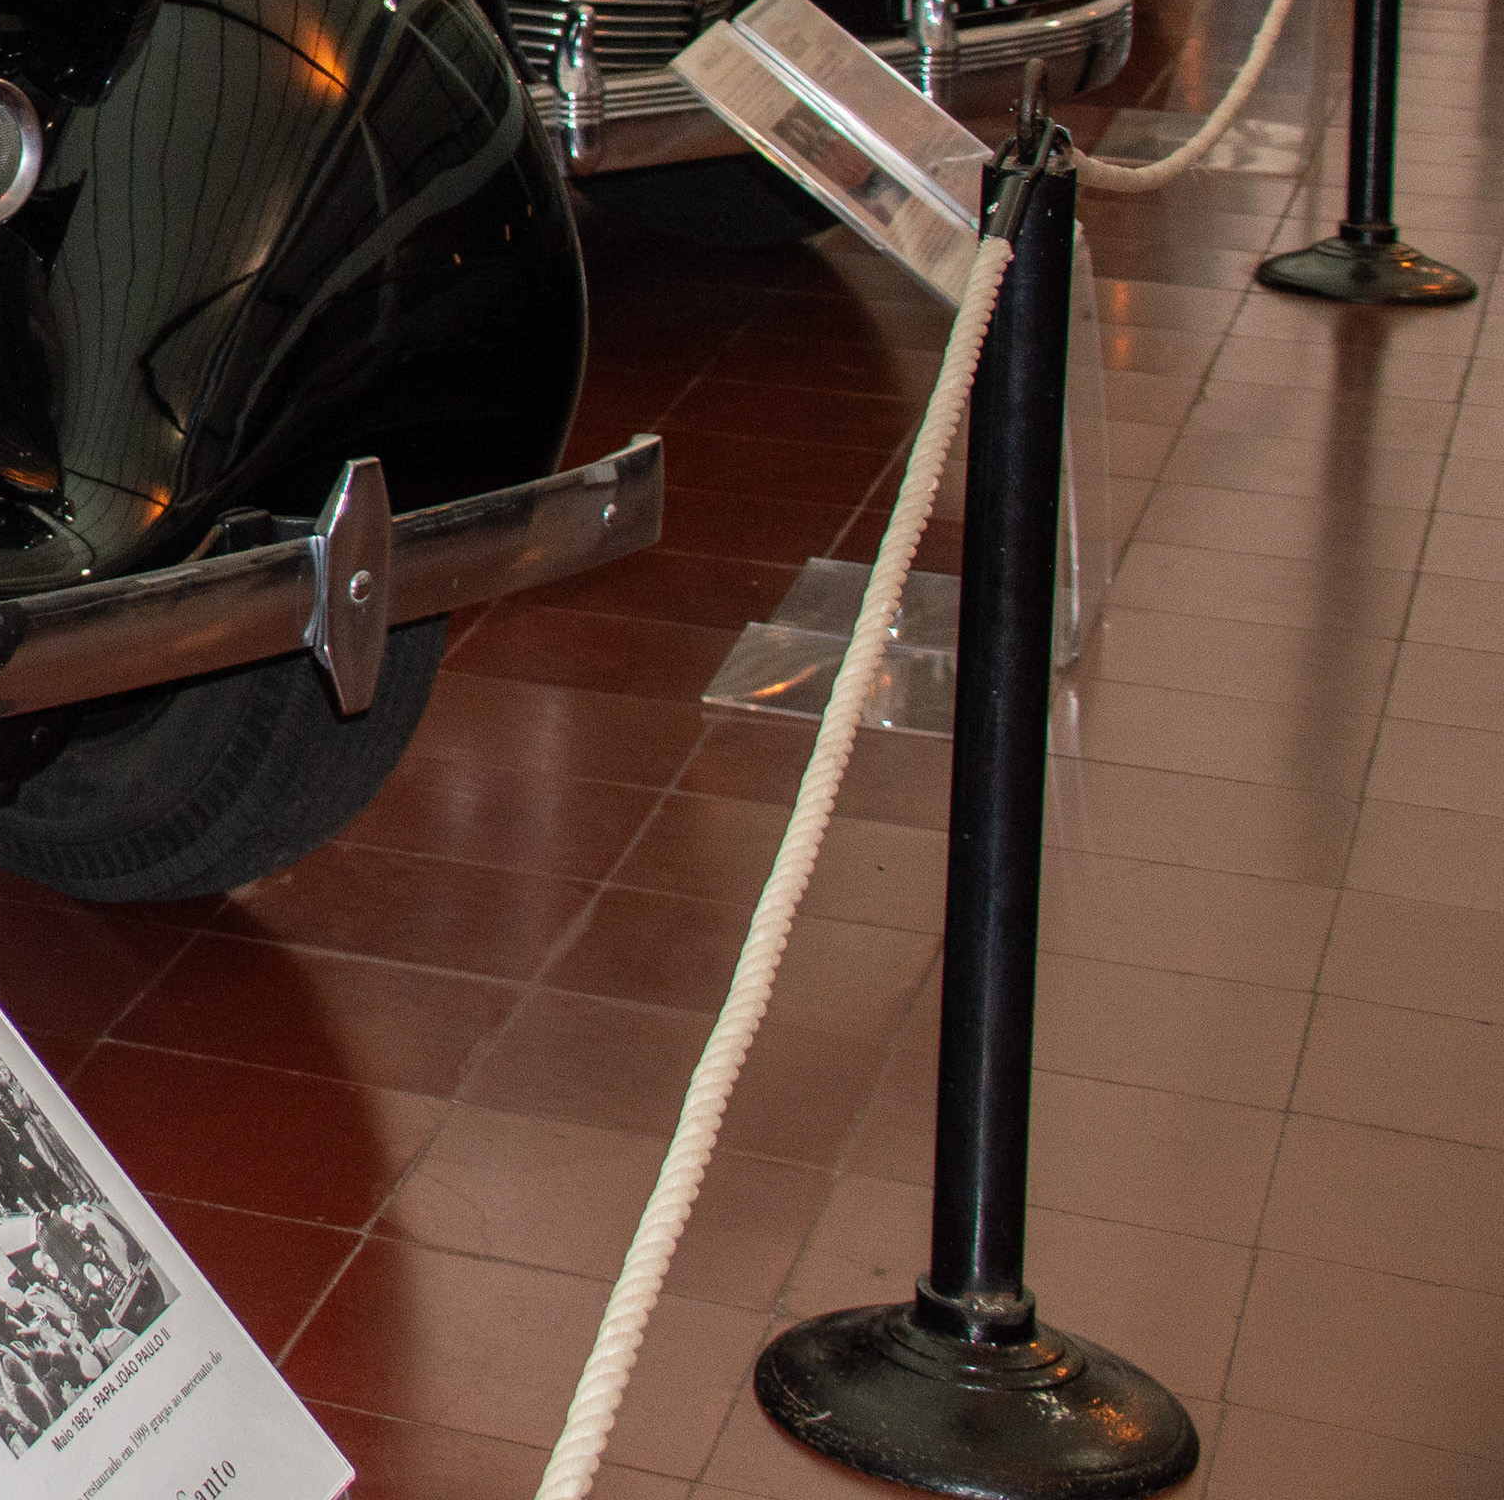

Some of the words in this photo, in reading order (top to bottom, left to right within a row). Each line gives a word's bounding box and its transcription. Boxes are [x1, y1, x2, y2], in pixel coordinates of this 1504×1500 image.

[51, 1428, 75, 1452] Maio
[71, 1407, 94, 1432] 1982
[92, 1381, 119, 1409] PAPA
[114, 1359, 139, 1389] JOÃO
[134, 1333, 164, 1367] PAULO
[159, 1326, 172, 1341] II
[121, 1445, 135, 1461] em
[129, 1423, 151, 1449] 1999
[149, 1405, 174, 1435] graças
[171, 1394, 183, 1408] ao
[180, 1362, 213, 1398] mecenato
[210, 1351, 223, 1365] do
